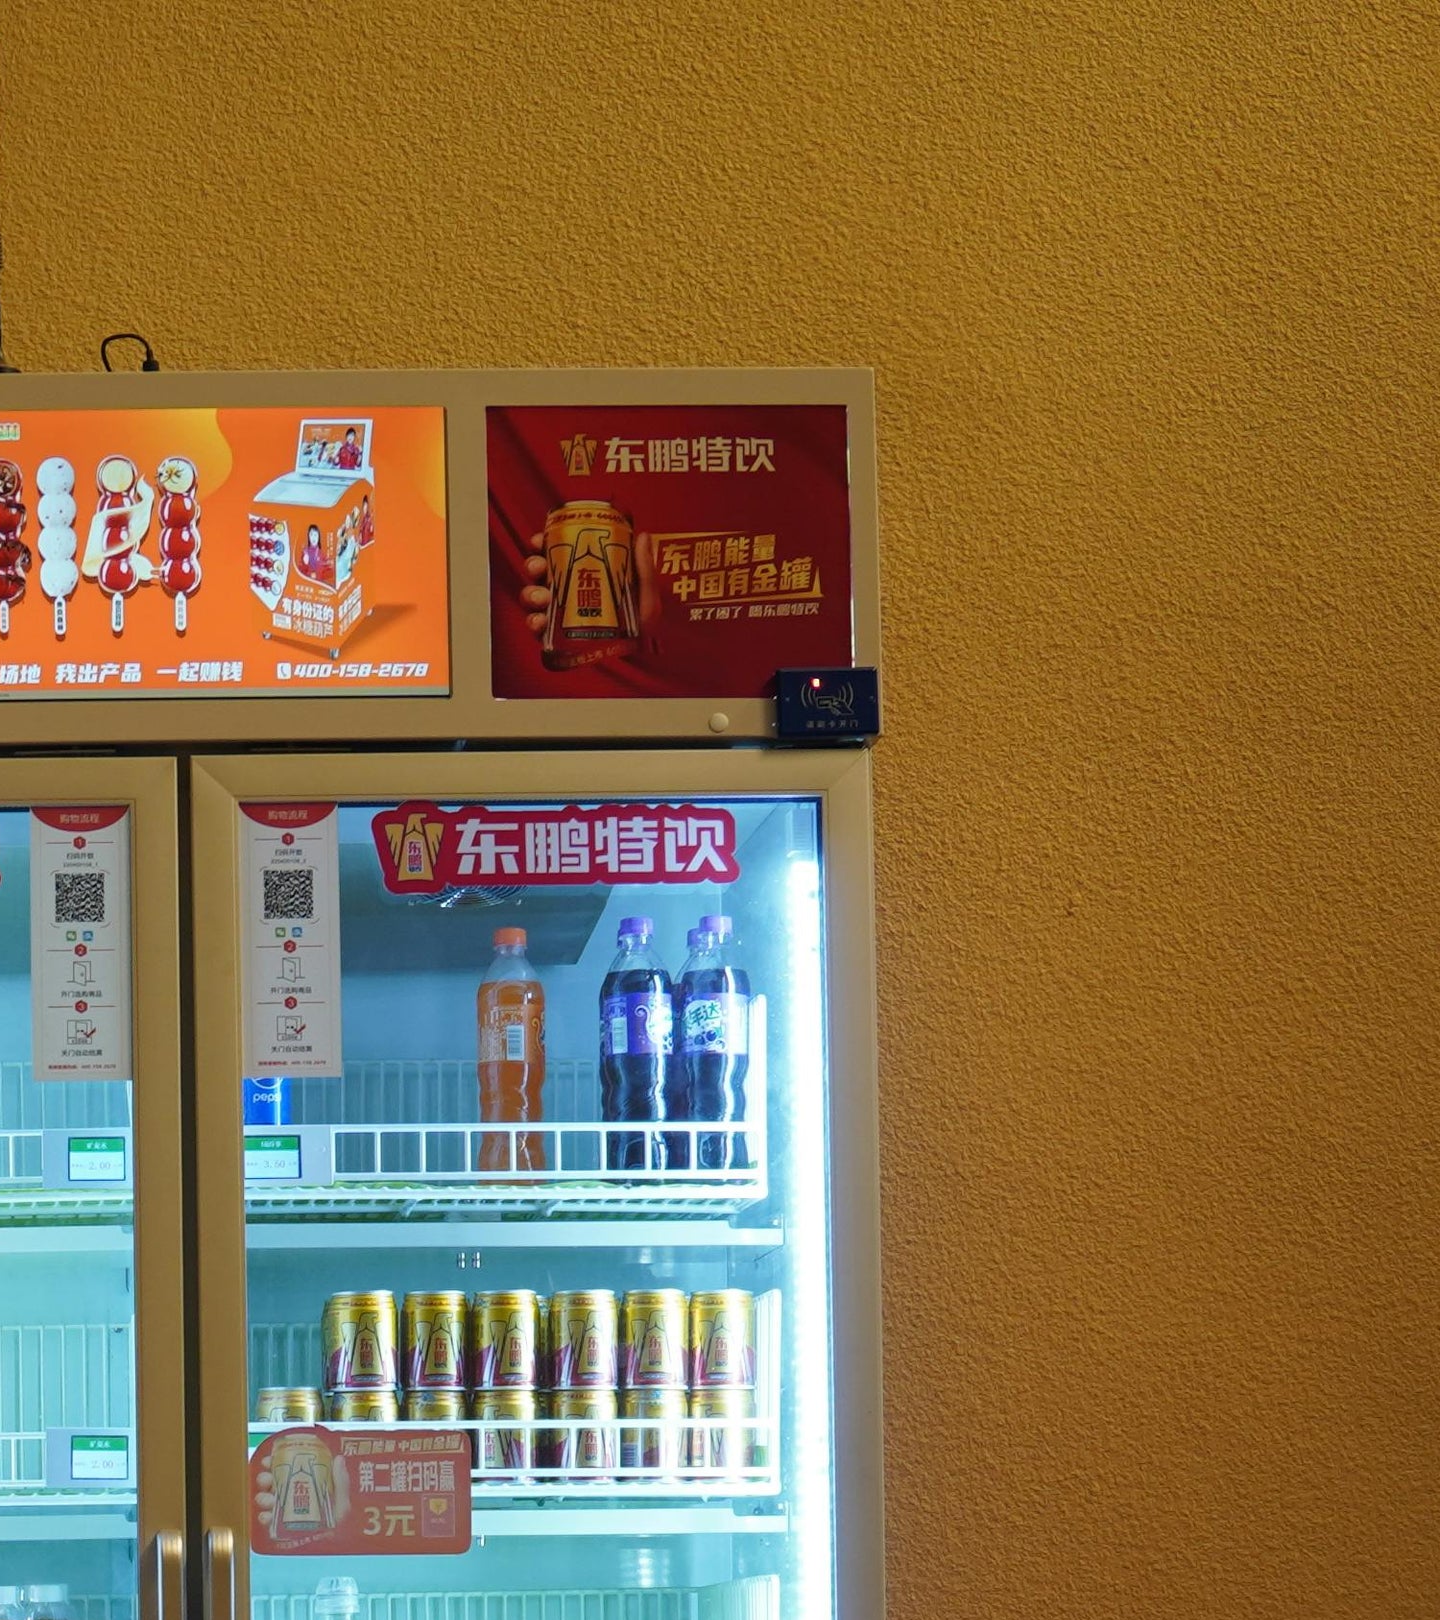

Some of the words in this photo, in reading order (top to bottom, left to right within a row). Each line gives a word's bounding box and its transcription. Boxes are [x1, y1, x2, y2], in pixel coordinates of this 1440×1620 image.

[604, 437, 776, 473] 东鹏特饮
[660, 534, 776, 575] 东鹏能量
[673, 556, 814, 602] 中国有金罐
[55, 662, 142, 684] 我出产品
[156, 661, 244, 683] 一起赚钱
[293, 661, 429, 679] 400-158-2678
[455, 817, 727, 875] 东鹏特饮
[359, 1460, 455, 1493] 第二罐扫码赢
[363, 1505, 416, 1536] 3元
